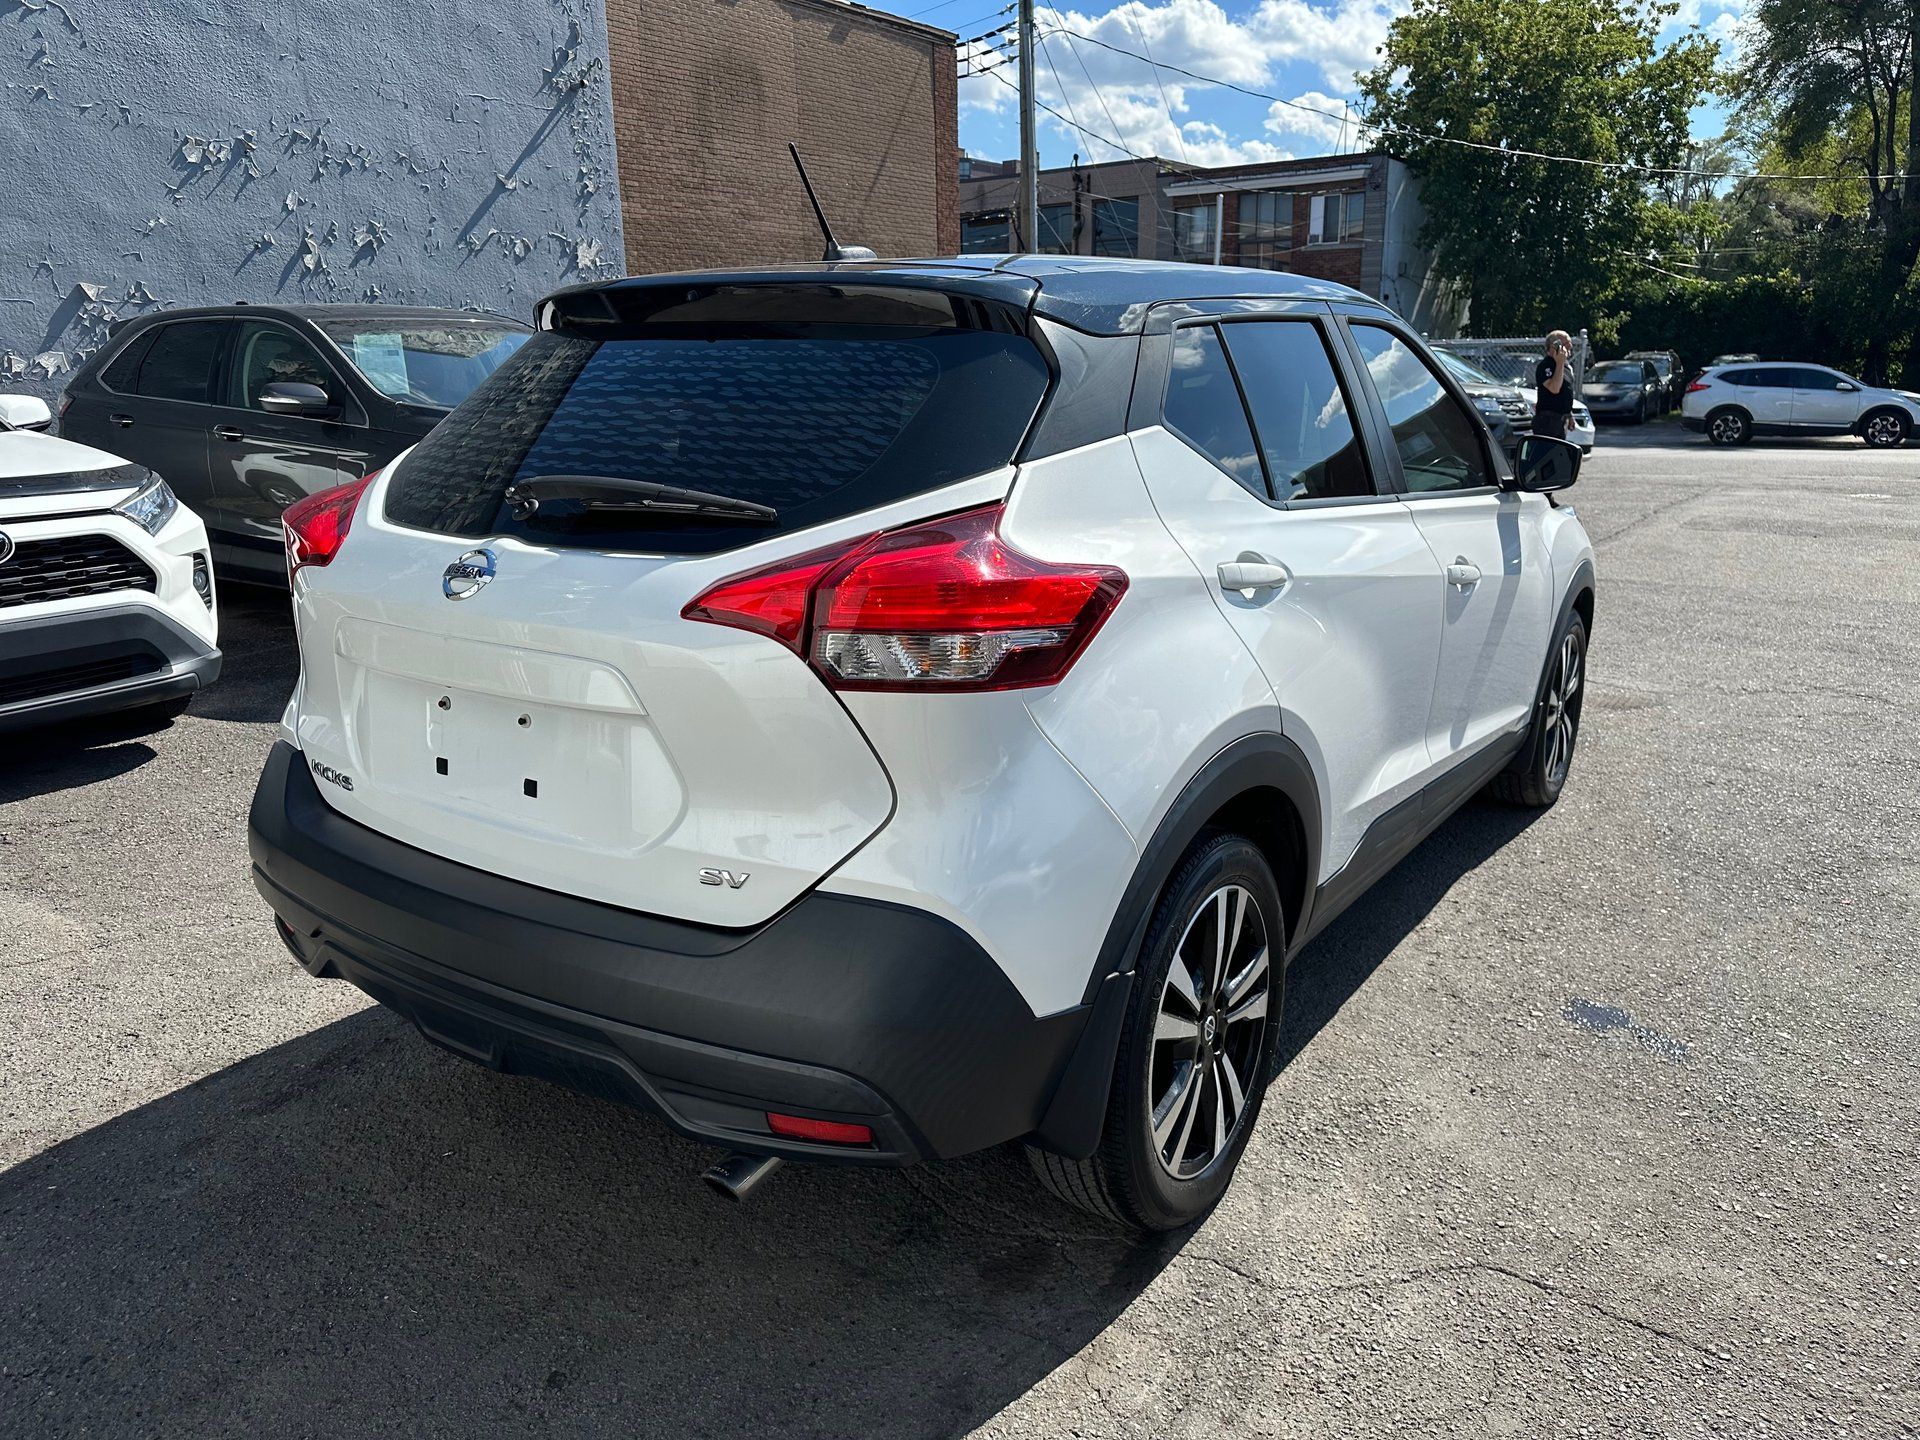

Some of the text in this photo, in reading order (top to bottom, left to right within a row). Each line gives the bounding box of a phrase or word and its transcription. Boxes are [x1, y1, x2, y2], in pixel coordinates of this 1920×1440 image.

[446, 564, 486, 579] NISSAN
[311, 759, 354, 791] KICKS
[699, 867, 750, 889] SV
